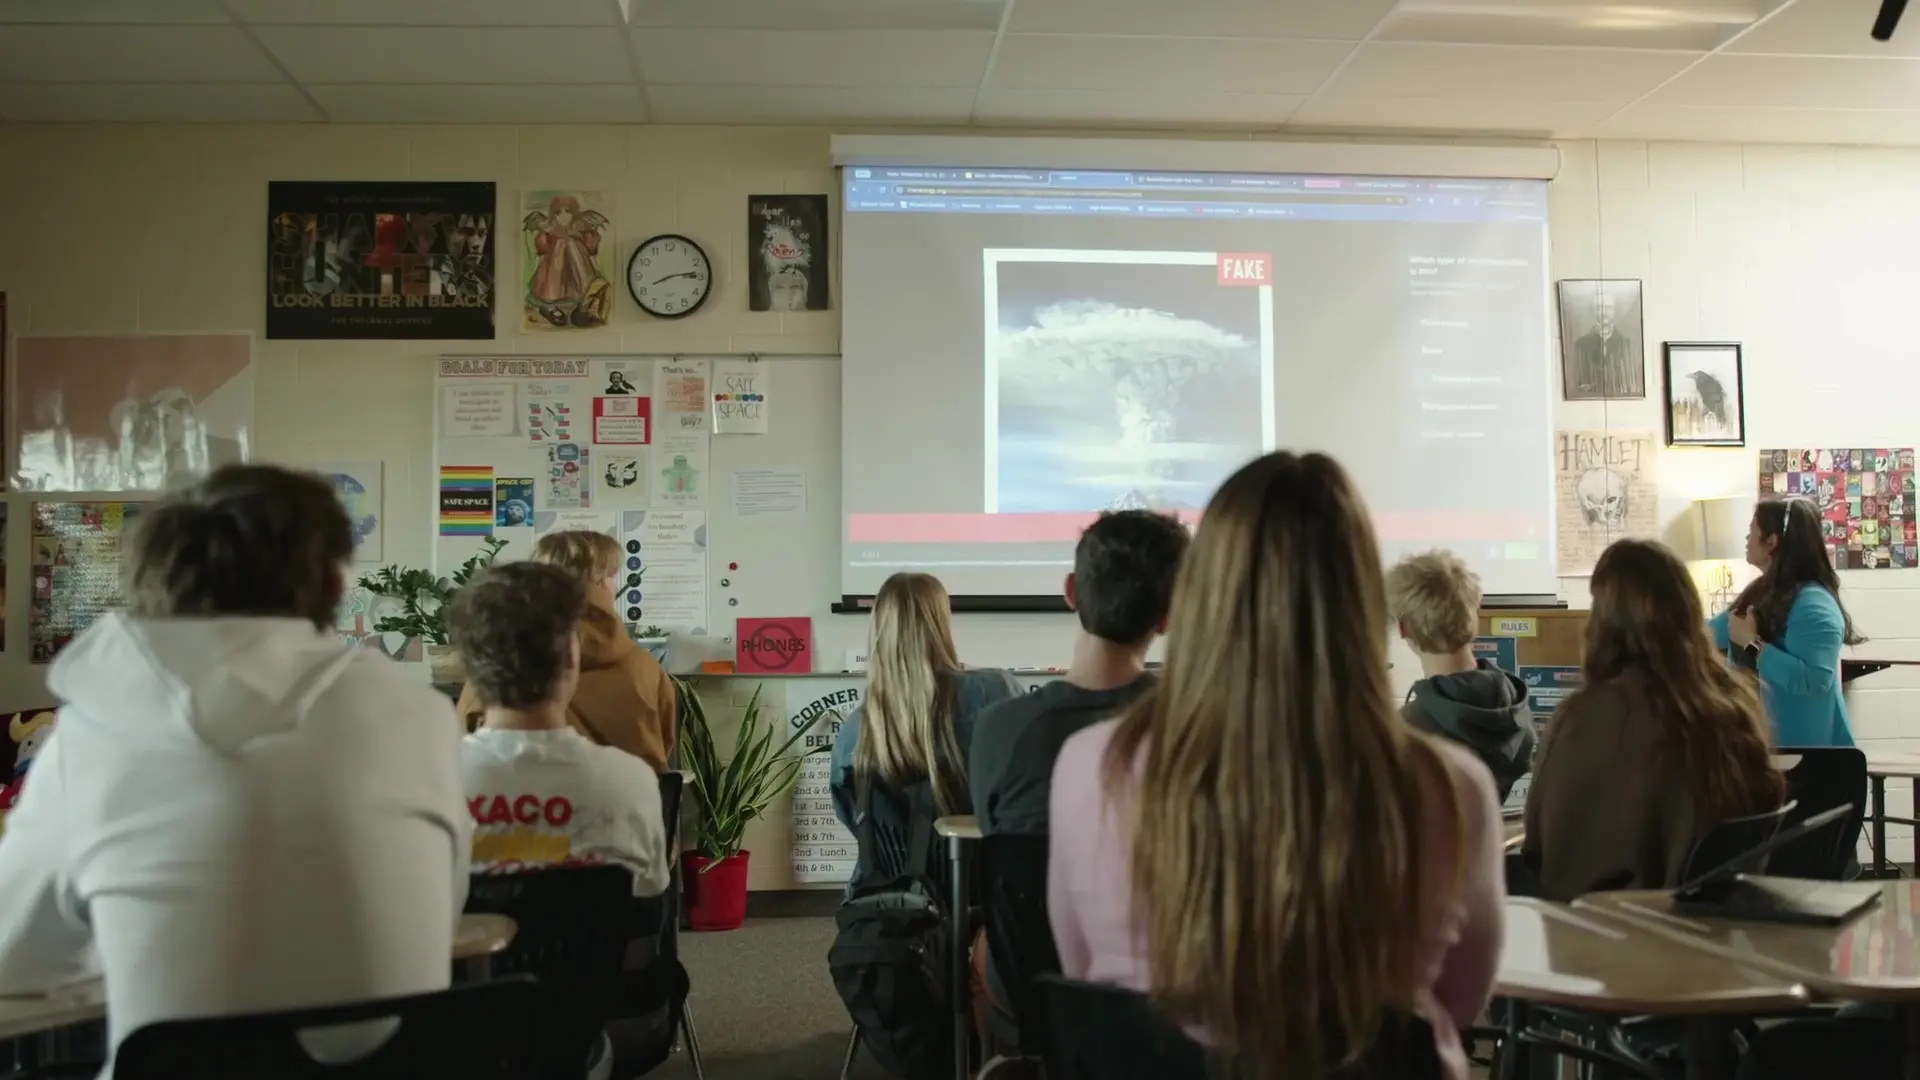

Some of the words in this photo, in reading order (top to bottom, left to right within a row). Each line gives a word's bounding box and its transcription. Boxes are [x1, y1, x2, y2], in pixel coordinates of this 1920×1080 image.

[652, 247, 659, 256] 11
[664, 243, 675, 252] 12
[640, 258, 651, 267] 10
[692, 259, 700, 267] 2
[1223, 258, 1265, 280] FAKE
[640, 287, 648, 296] 8
[692, 288, 699, 296] 4
[273, 295, 324, 308] LOOK
[330, 295, 401, 308] BETTER
[406, 295, 423, 308] IN
[428, 295, 489, 308] BLACK
[665, 302, 673, 312] 6
[441, 360, 493, 374] GOALS
[498, 360, 530, 375] FOR
[533, 360, 587, 374] TODAY
[725, 376, 756, 393] SAFE
[719, 403, 763, 420] SPACE
[1559, 434, 1649, 472] HAMLET
[443, 498, 464, 506] SAFE
[464, 498, 490, 506] SPACE
[1500, 622, 1529, 633] RULES
[741, 638, 806, 652] PHONES
[791, 688, 860, 730] CORNER
[805, 735, 831, 747] BEL
[794, 785, 812, 795] 2nd
[795, 801, 808, 811] 1st
[795, 817, 808, 826] 3rd
[811, 817, 818, 826] &
[821, 816, 835, 826] 7th
[795, 832, 808, 842] 3rd
[811, 832, 818, 841] &
[821, 831, 835, 841] 7th
[795, 848, 812, 857] 2nd
[820, 847, 847, 857] Lunch
[795, 863, 809, 873] 4th
[811, 864, 818, 873] &
[820, 863, 834, 873] 8th
